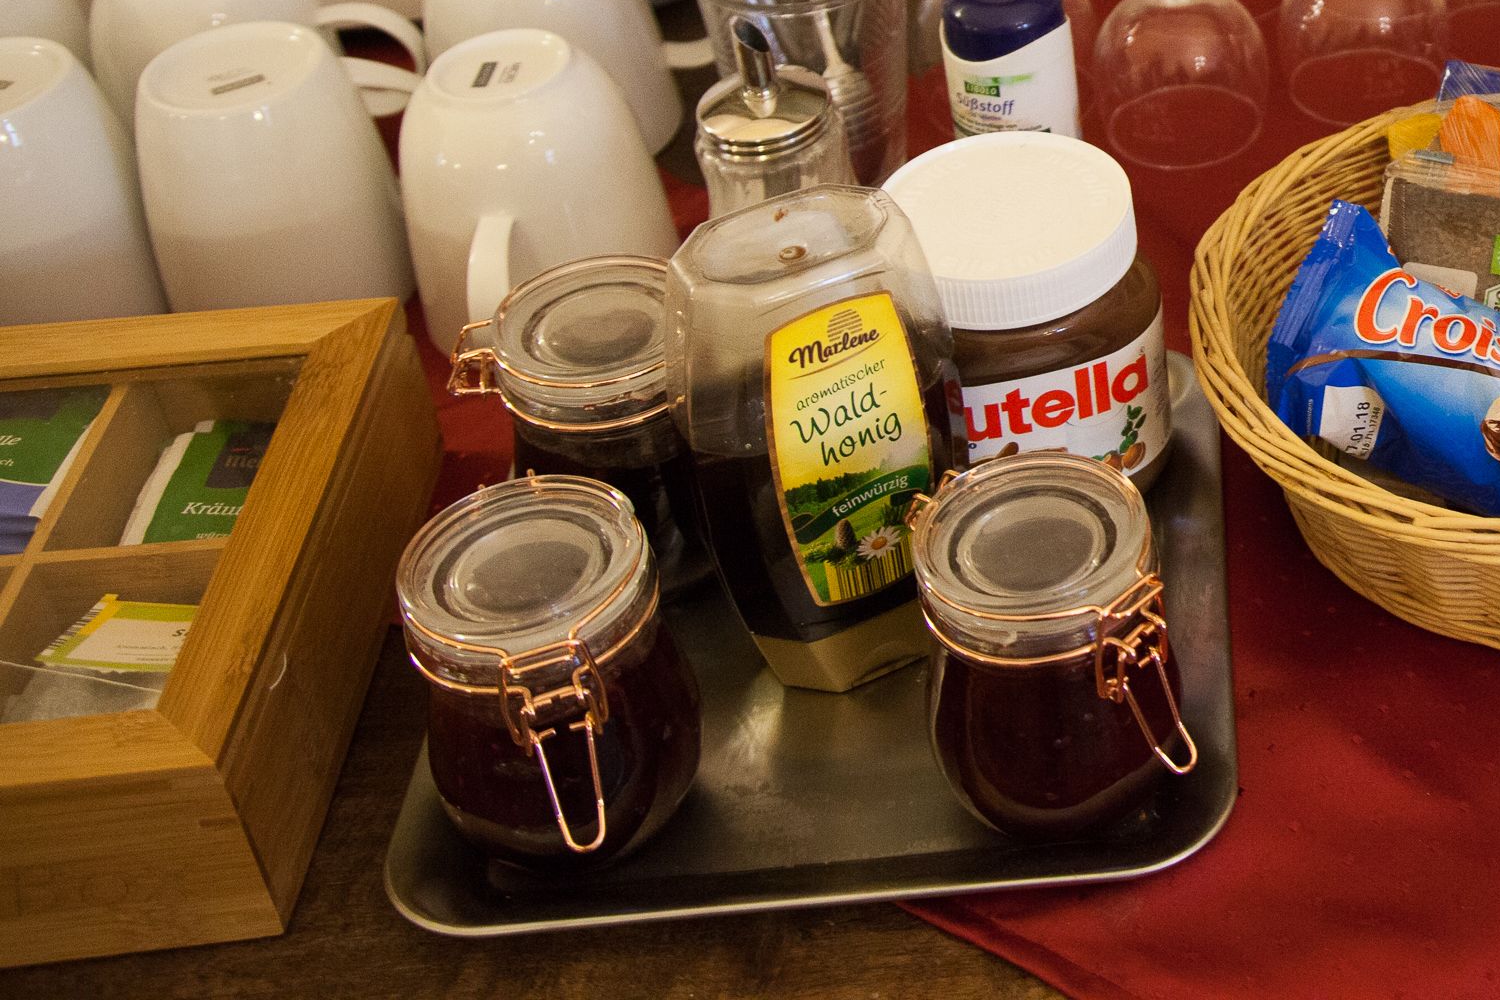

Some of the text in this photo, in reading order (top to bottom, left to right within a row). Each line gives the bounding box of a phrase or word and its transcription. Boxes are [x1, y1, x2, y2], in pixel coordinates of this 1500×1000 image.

[788, 329, 880, 369] Marlene
[796, 358, 886, 412] aromatischer
[964, 354, 1149, 441] utella
[789, 382, 888, 444] Wald-
[821, 412, 902, 466] honig
[1345, 401, 1371, 454] 7.01.18
[831, 474, 909, 518] feinwürzig
